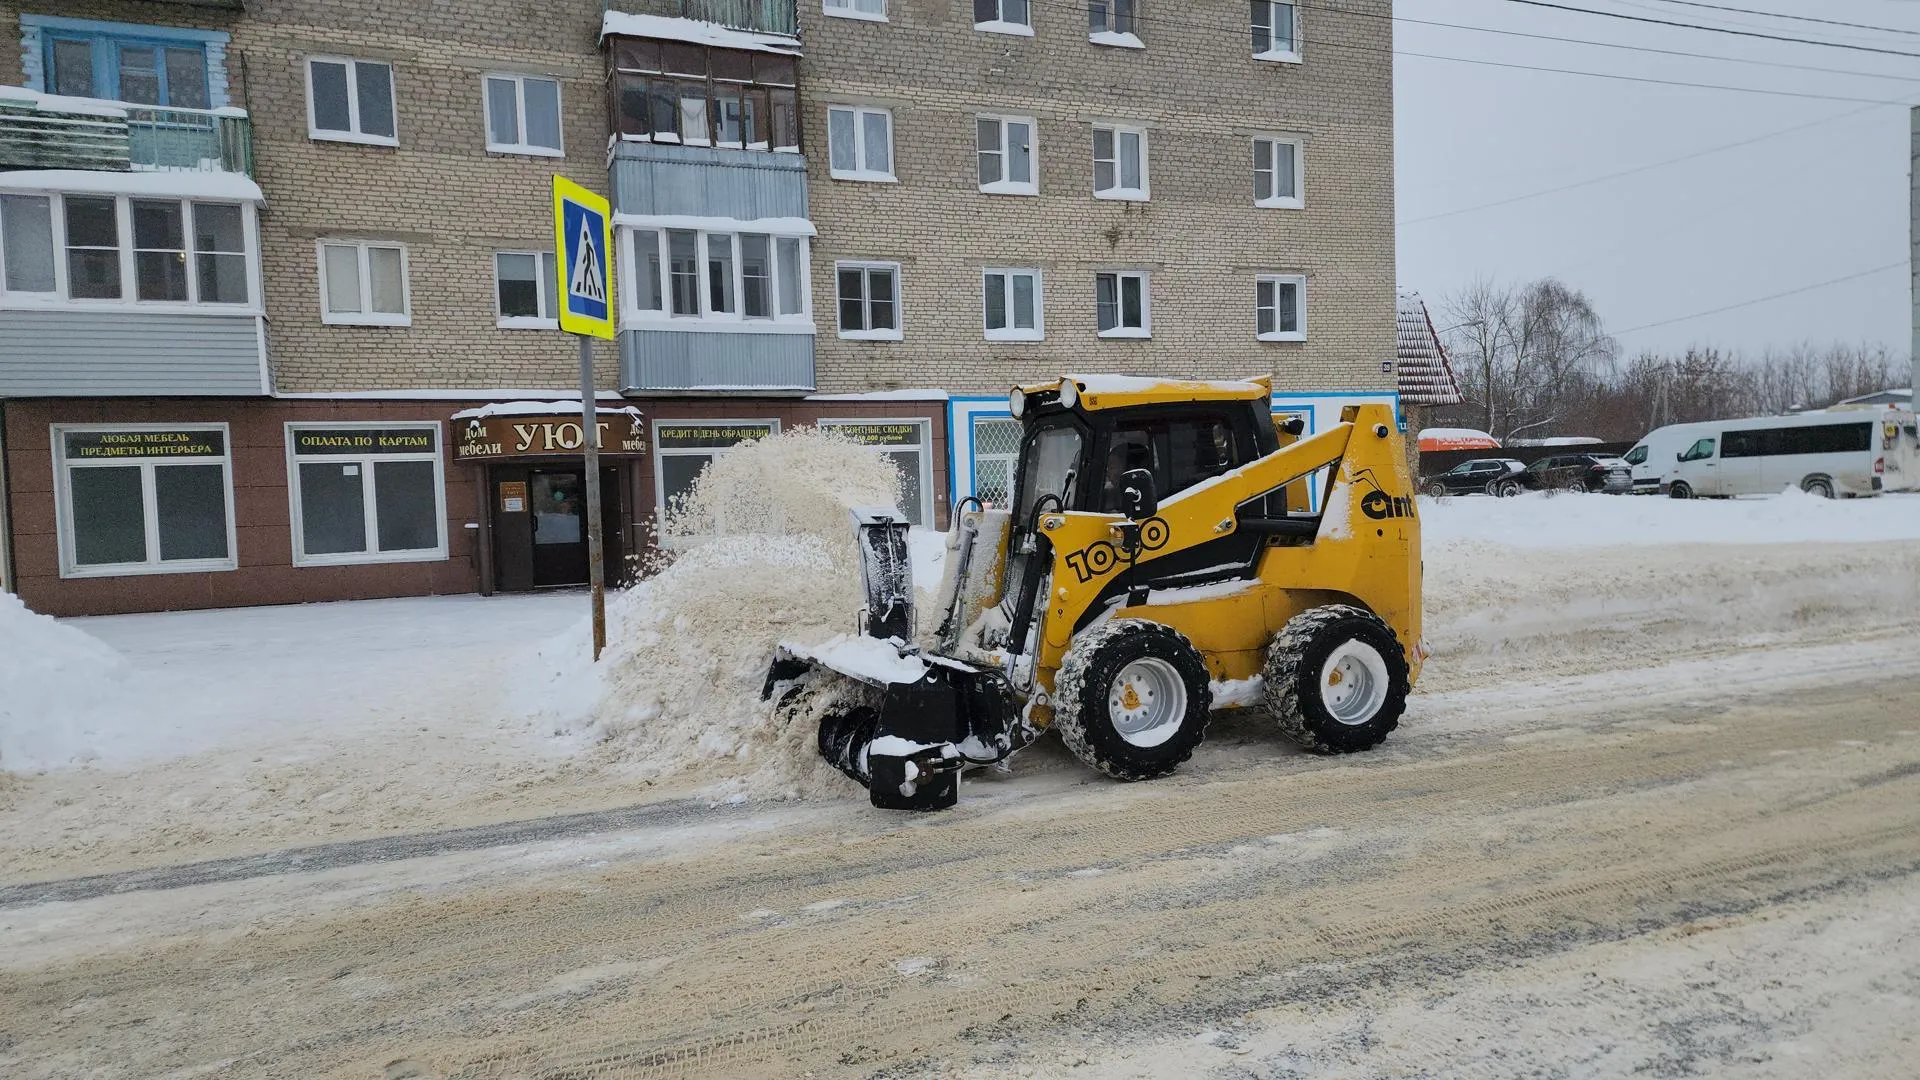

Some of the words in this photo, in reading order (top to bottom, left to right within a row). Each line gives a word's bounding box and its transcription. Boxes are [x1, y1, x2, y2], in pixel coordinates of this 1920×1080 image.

[661, 429, 692, 439] КРЕДИТ
[700, 429, 720, 439] ДЕНЬ
[721, 429, 769, 439] ОБРАЩЕНИЯ
[883, 424, 913, 435] СКИДКИ
[100, 433, 142, 444] ЛЮБАЯ
[144, 433, 190, 443] МЕБЕЛЬ
[301, 436, 352, 446] ОПЛАТА
[354, 436, 373, 446] ПО
[379, 436, 428, 446] КАРТАМ
[513, 422, 609, 451] УЮТ
[880, 434, 903, 444] рублей
[80, 446, 144, 457] ПРЕДМЕТЫ
[146, 444, 212, 455] ИНТЕРЬЕРА
[459, 436, 502, 456] мебели
[1361, 490, 1415, 520] ant
